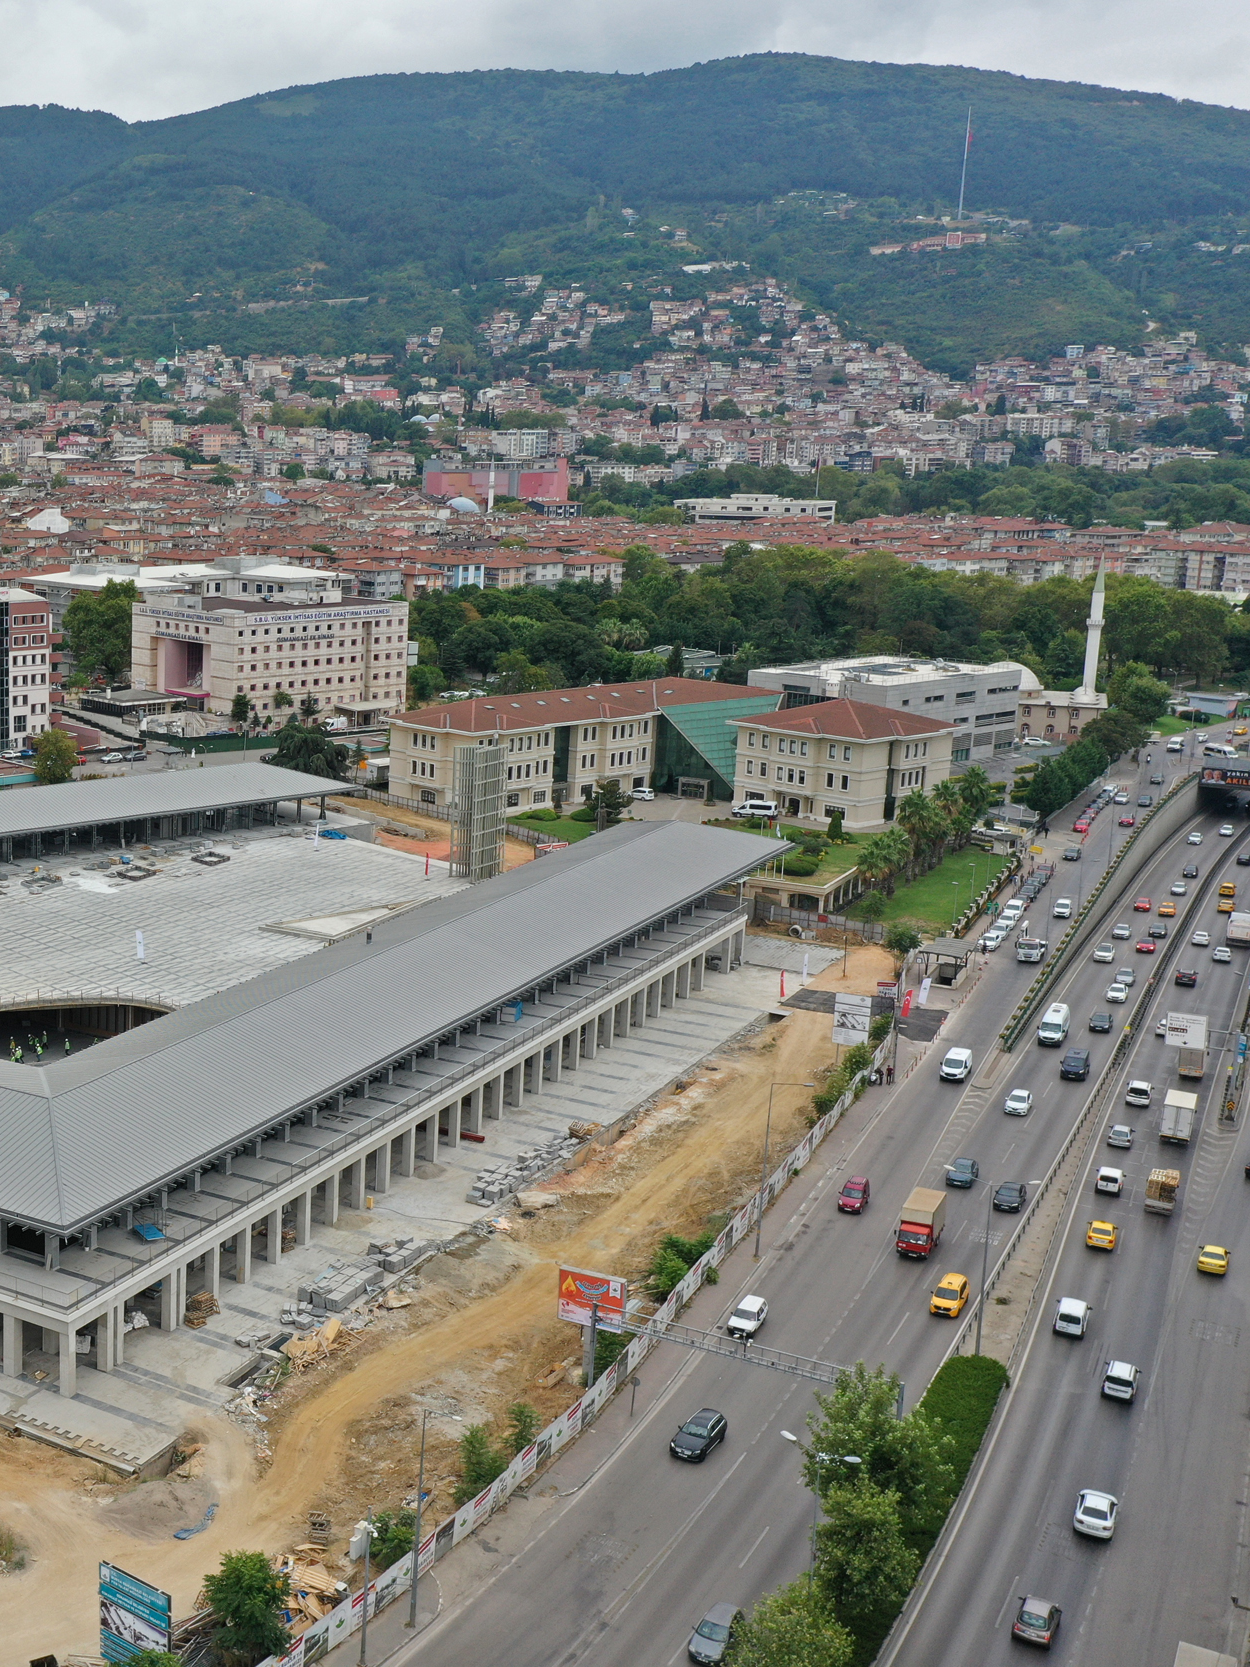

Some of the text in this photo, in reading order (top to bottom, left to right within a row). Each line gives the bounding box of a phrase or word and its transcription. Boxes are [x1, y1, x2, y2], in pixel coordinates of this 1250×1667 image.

[271, 614, 292, 622] YÜKSEK
[333, 610, 362, 619] ARAŞTIRMA
[363, 608, 390, 616] HASTANESİ
[277, 635, 309, 643] OSMANGAZİ
